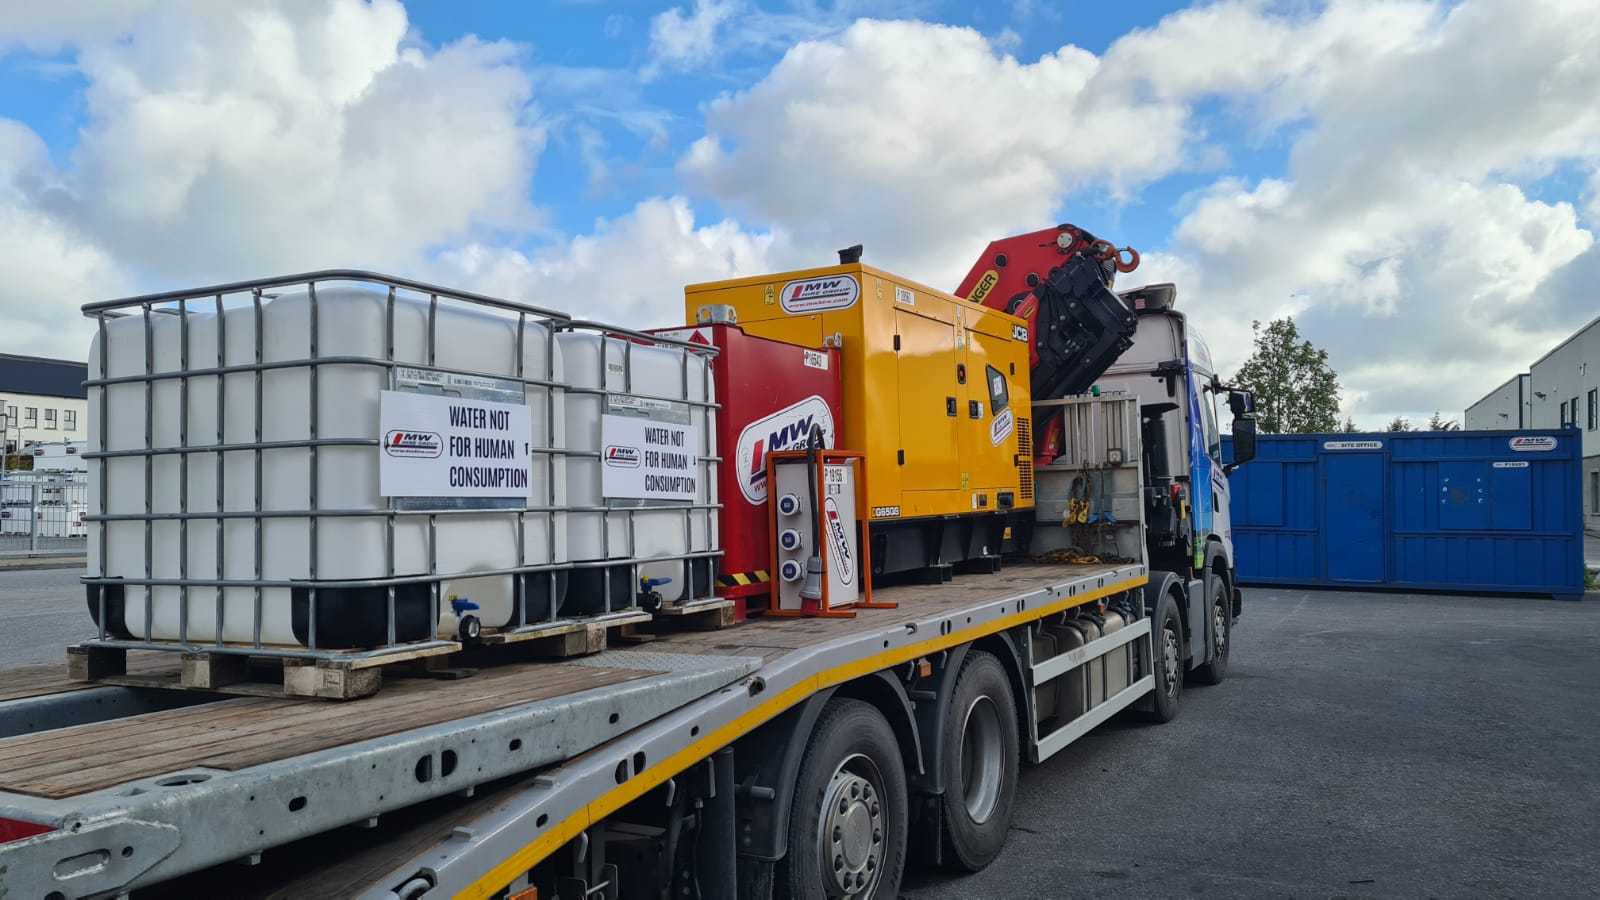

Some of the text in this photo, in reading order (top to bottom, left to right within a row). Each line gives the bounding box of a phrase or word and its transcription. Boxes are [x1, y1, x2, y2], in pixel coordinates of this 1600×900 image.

[804, 280, 842, 292] MW
[1013, 325, 1028, 342] JCB
[449, 406, 510, 431] WATER NOT
[404, 433, 432, 441] MW
[645, 426, 684, 447] WATER NOT
[769, 414, 814, 453] MW
[449, 436, 514, 459] FOR HUMAN
[645, 450, 688, 470] FOR HUMAN
[449, 466, 528, 488] CONSUMPTION
[645, 474, 696, 494] CONSUMPTION
